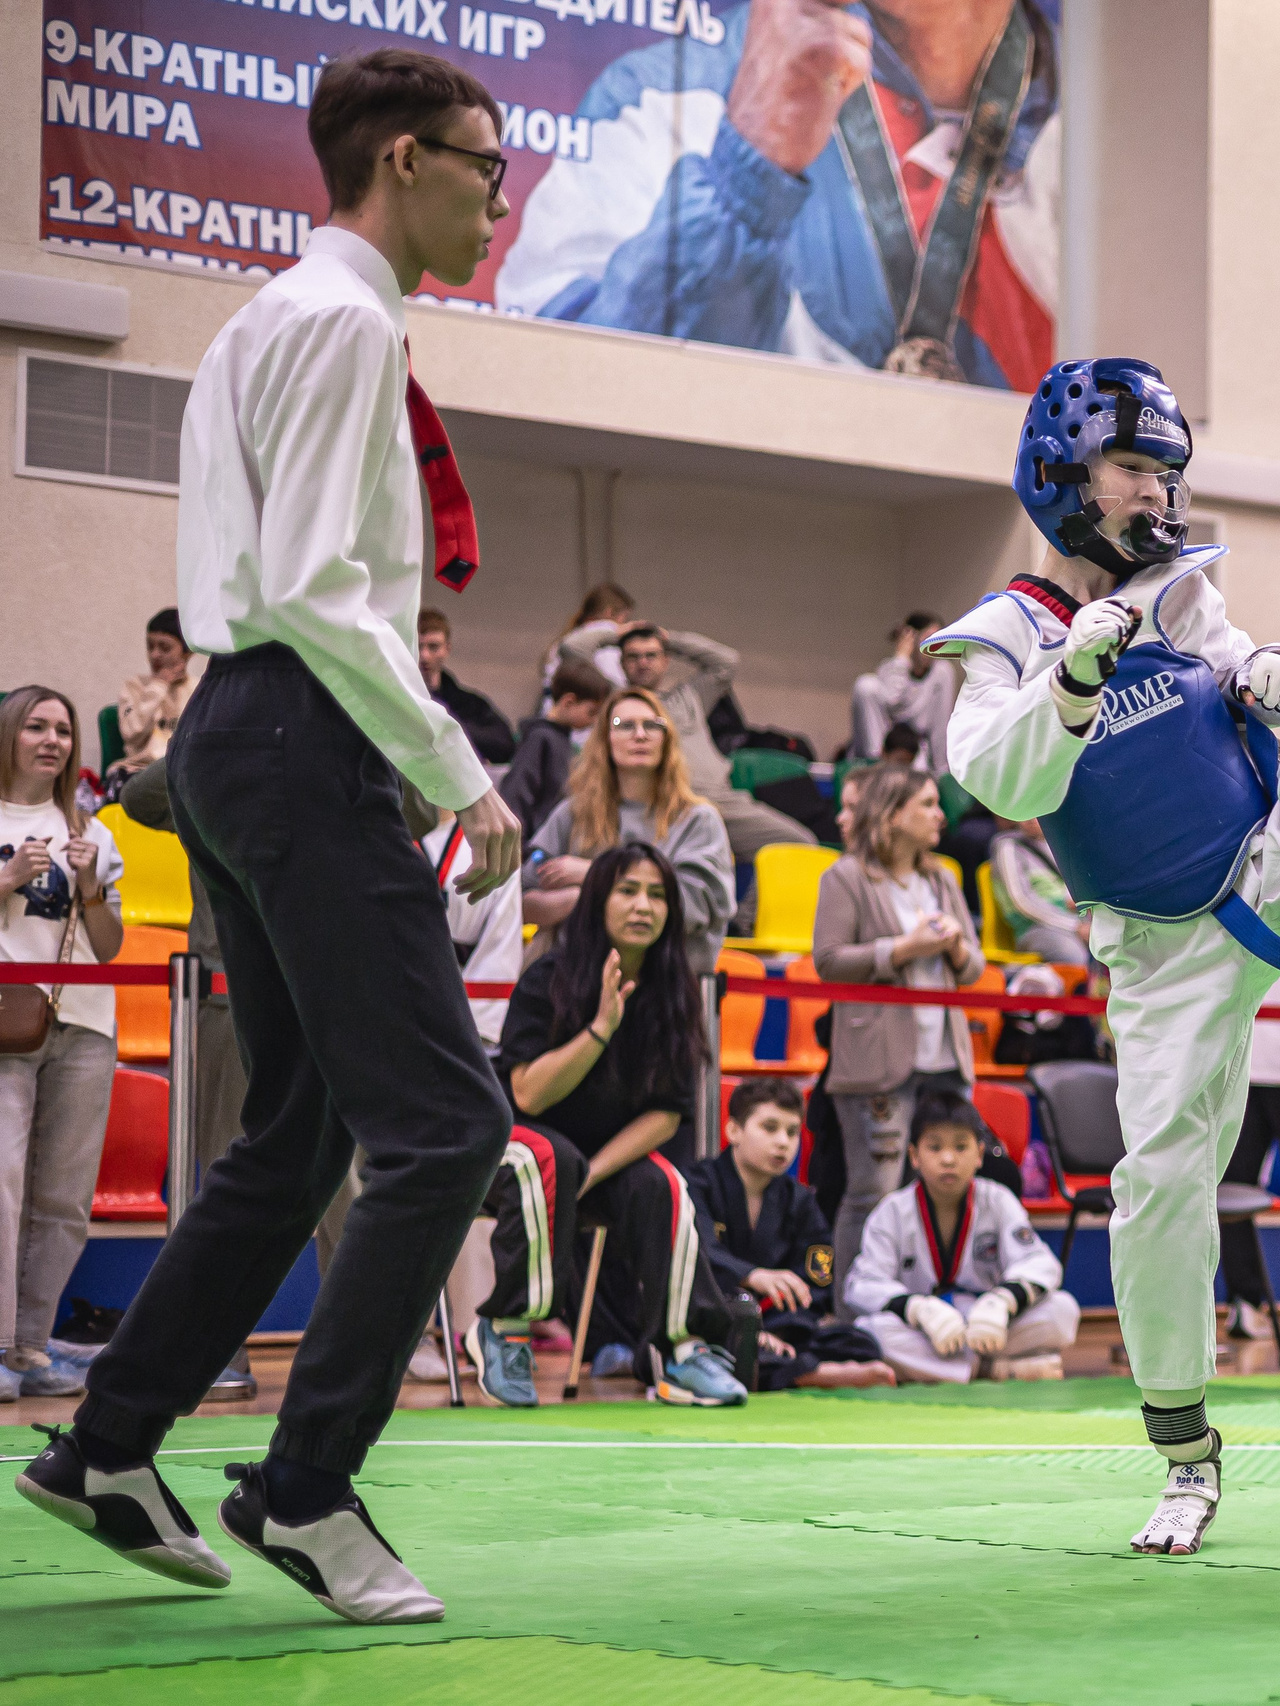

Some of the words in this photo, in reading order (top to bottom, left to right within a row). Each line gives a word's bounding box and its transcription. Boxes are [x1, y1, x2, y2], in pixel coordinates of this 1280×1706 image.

[45, 19, 326, 108] 9-КРАТНЫ
[458, 4, 547, 61] ИГР
[46, 78, 201, 148] МИРА
[1111, 709, 1155, 732] taekwondo
[1156, 697, 1181, 712] league
